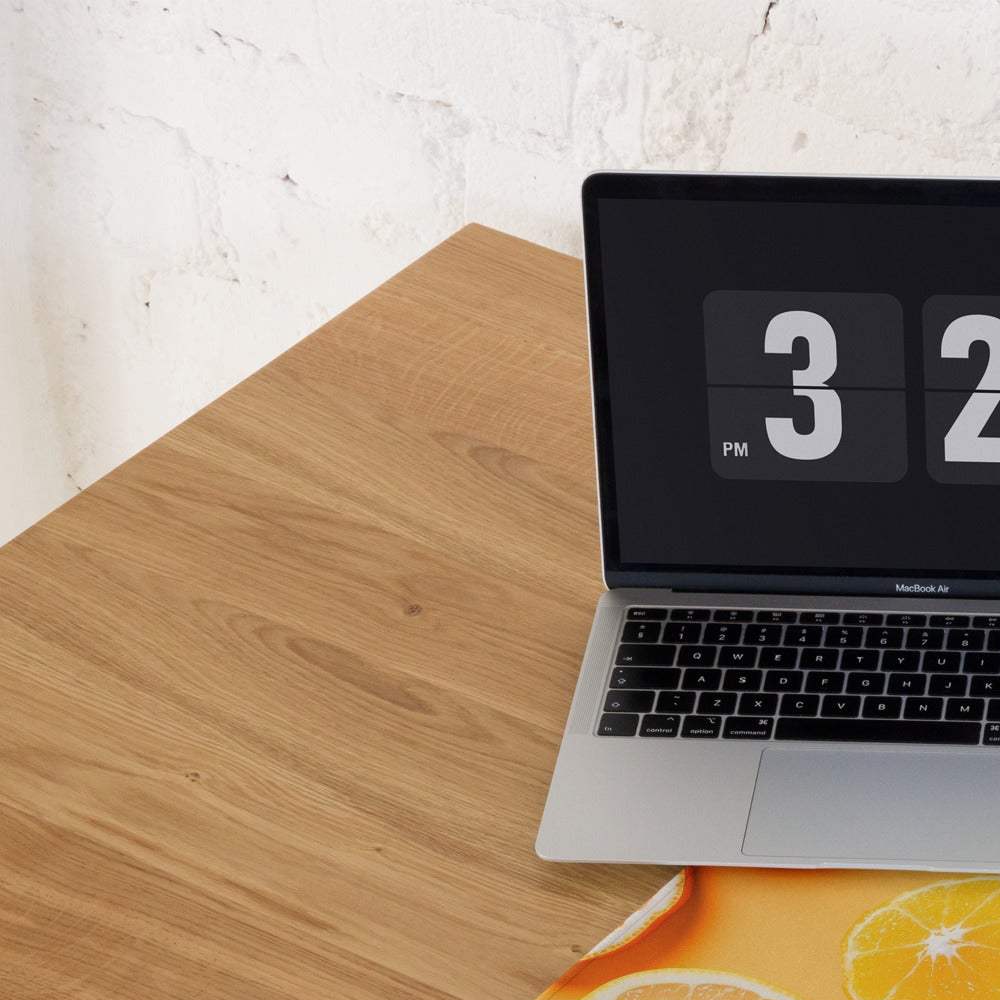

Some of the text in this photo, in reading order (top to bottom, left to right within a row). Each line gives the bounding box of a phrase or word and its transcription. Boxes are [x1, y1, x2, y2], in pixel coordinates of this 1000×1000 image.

[763, 310, 843, 461] 3
[722, 442, 749, 457] PM
[895, 583, 950, 593] MacBook Air
[718, 633, 726, 641] 2
[961, 639, 969, 647] 8
[692, 652, 702, 660] Q
[779, 677, 788, 685] D
[821, 678, 829, 686] F
[861, 679, 870, 687] G
[713, 699, 721, 707] Z
[795, 701, 804, 709] C
[878, 703, 886, 711] B
[919, 704, 928, 712] N
